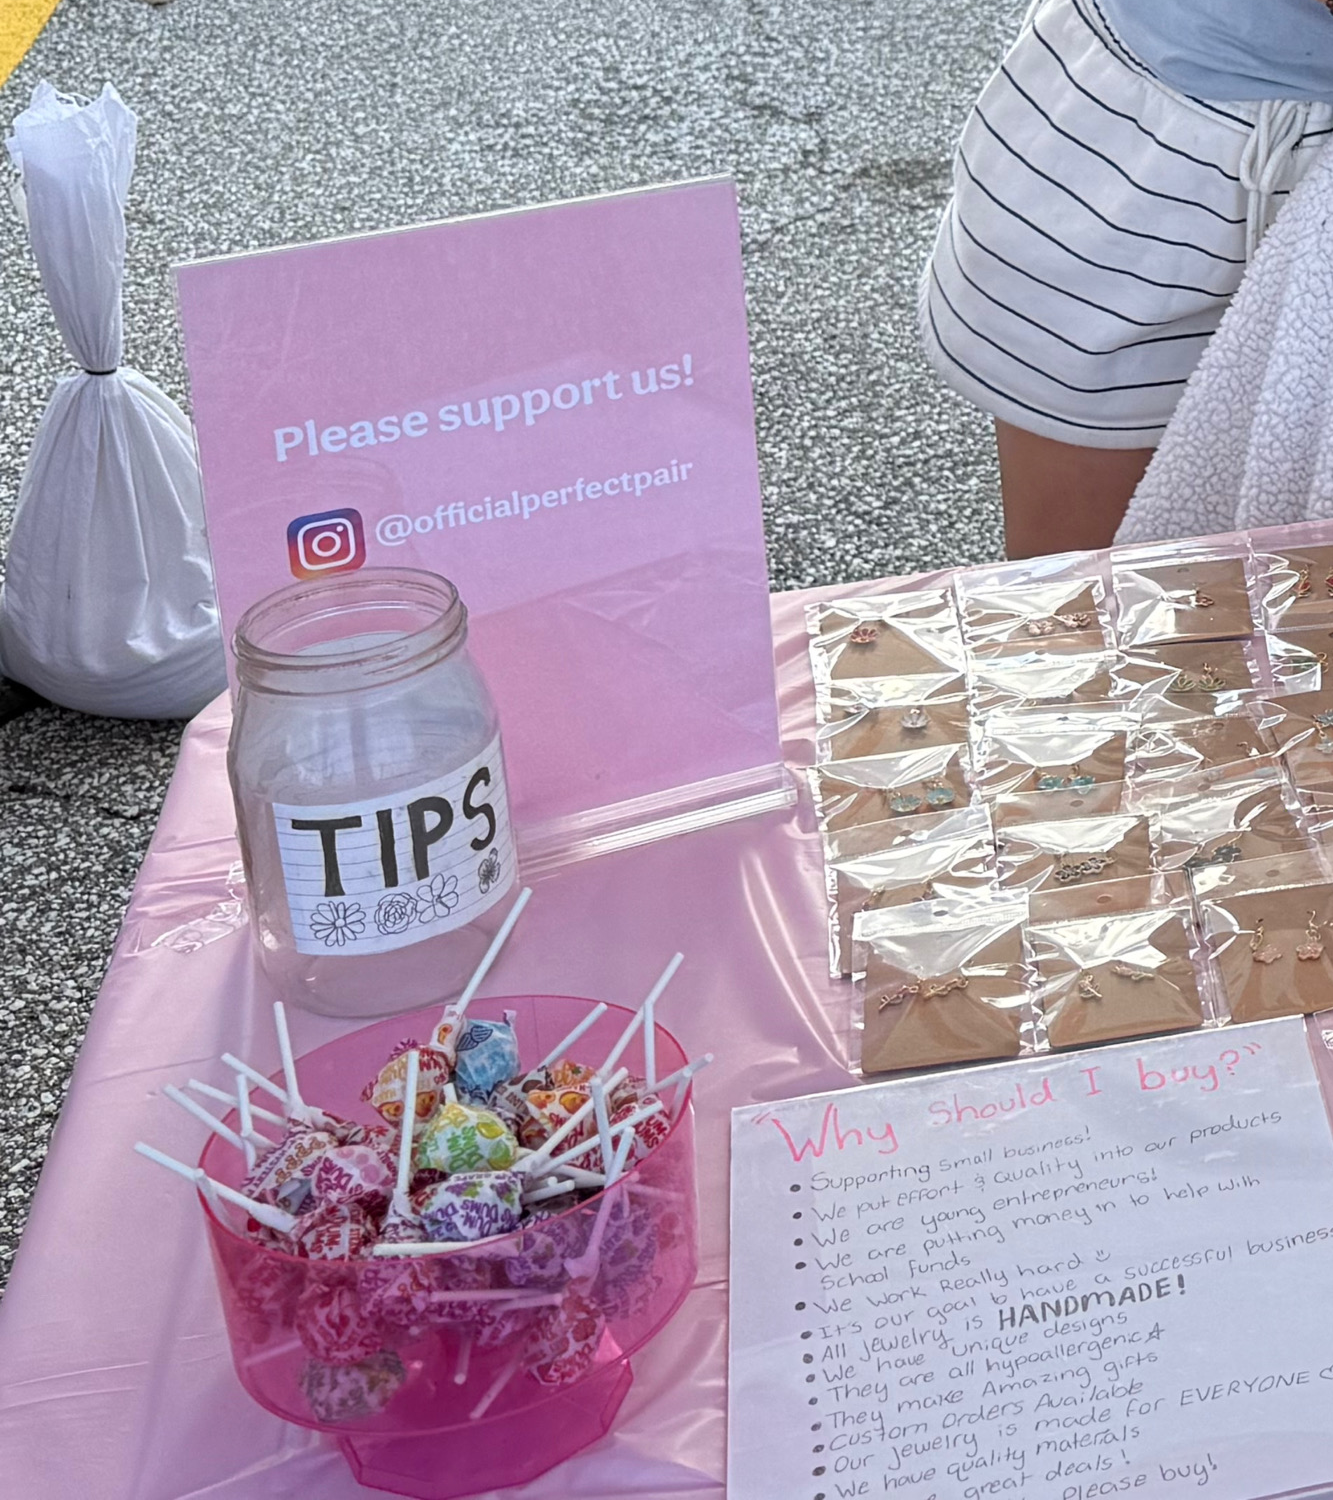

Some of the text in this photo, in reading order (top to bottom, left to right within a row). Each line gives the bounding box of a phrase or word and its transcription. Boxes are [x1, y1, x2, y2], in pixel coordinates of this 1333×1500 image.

[274, 353, 695, 462] Please support us!
[375, 459, 693, 547] @officialperfectpair
[291, 766, 497, 898] TIPS
[1080, 1066, 1101, 1097] I
[810, 1164, 930, 1192] Supporting
[1003, 1125, 1091, 1159] business!
[811, 1204, 846, 1222] We
[857, 1195, 890, 1219] put
[897, 1183, 964, 1207] effort
[1094, 1145, 1134, 1162] into
[1145, 1137, 1176, 1153] our
[1190, 1110, 1281, 1144] products
[811, 1168, 1157, 1247] We are young entrepreneurs!
[815, 1252, 852, 1271] We
[868, 1243, 906, 1260] are
[923, 1225, 1005, 1255] putting
[1012, 1208, 1092, 1229] money
[1130, 1194, 1149, 1206] to
[1164, 1182, 1209, 1201] help
[813, 1298, 852, 1314] We
[1017, 1253, 1084, 1278] hard
[822, 1343, 846, 1362] All
[966, 1316, 983, 1331] is
[999, 1274, 1186, 1331] HANDMADE!
[874, 1310, 914, 1329] our
[927, 1297, 976, 1325] goal
[1021, 1279, 1077, 1301] have
[1094, 1273, 1111, 1285] a
[1125, 1246, 1233, 1280] successful
[823, 1364, 856, 1383] We
[877, 1354, 925, 1372] have
[1043, 1311, 1127, 1337] designs
[827, 1330, 1141, 1402] They are all hypoallergenic
[826, 1410, 883, 1429] They
[898, 1389, 964, 1413] make
[1103, 1351, 1158, 1381] gifts
[834, 1454, 875, 1473] Our
[998, 1423, 1017, 1437] is
[1035, 1408, 1111, 1432] made
[1126, 1398, 1165, 1418] for
[1180, 1371, 1310, 1406] EVERYONE
[830, 1422, 928, 1451] Custom
[835, 1426, 1140, 1498] We have quality materials
[1159, 1453, 1218, 1486] buy!
[964, 1475, 1032, 1499] great
